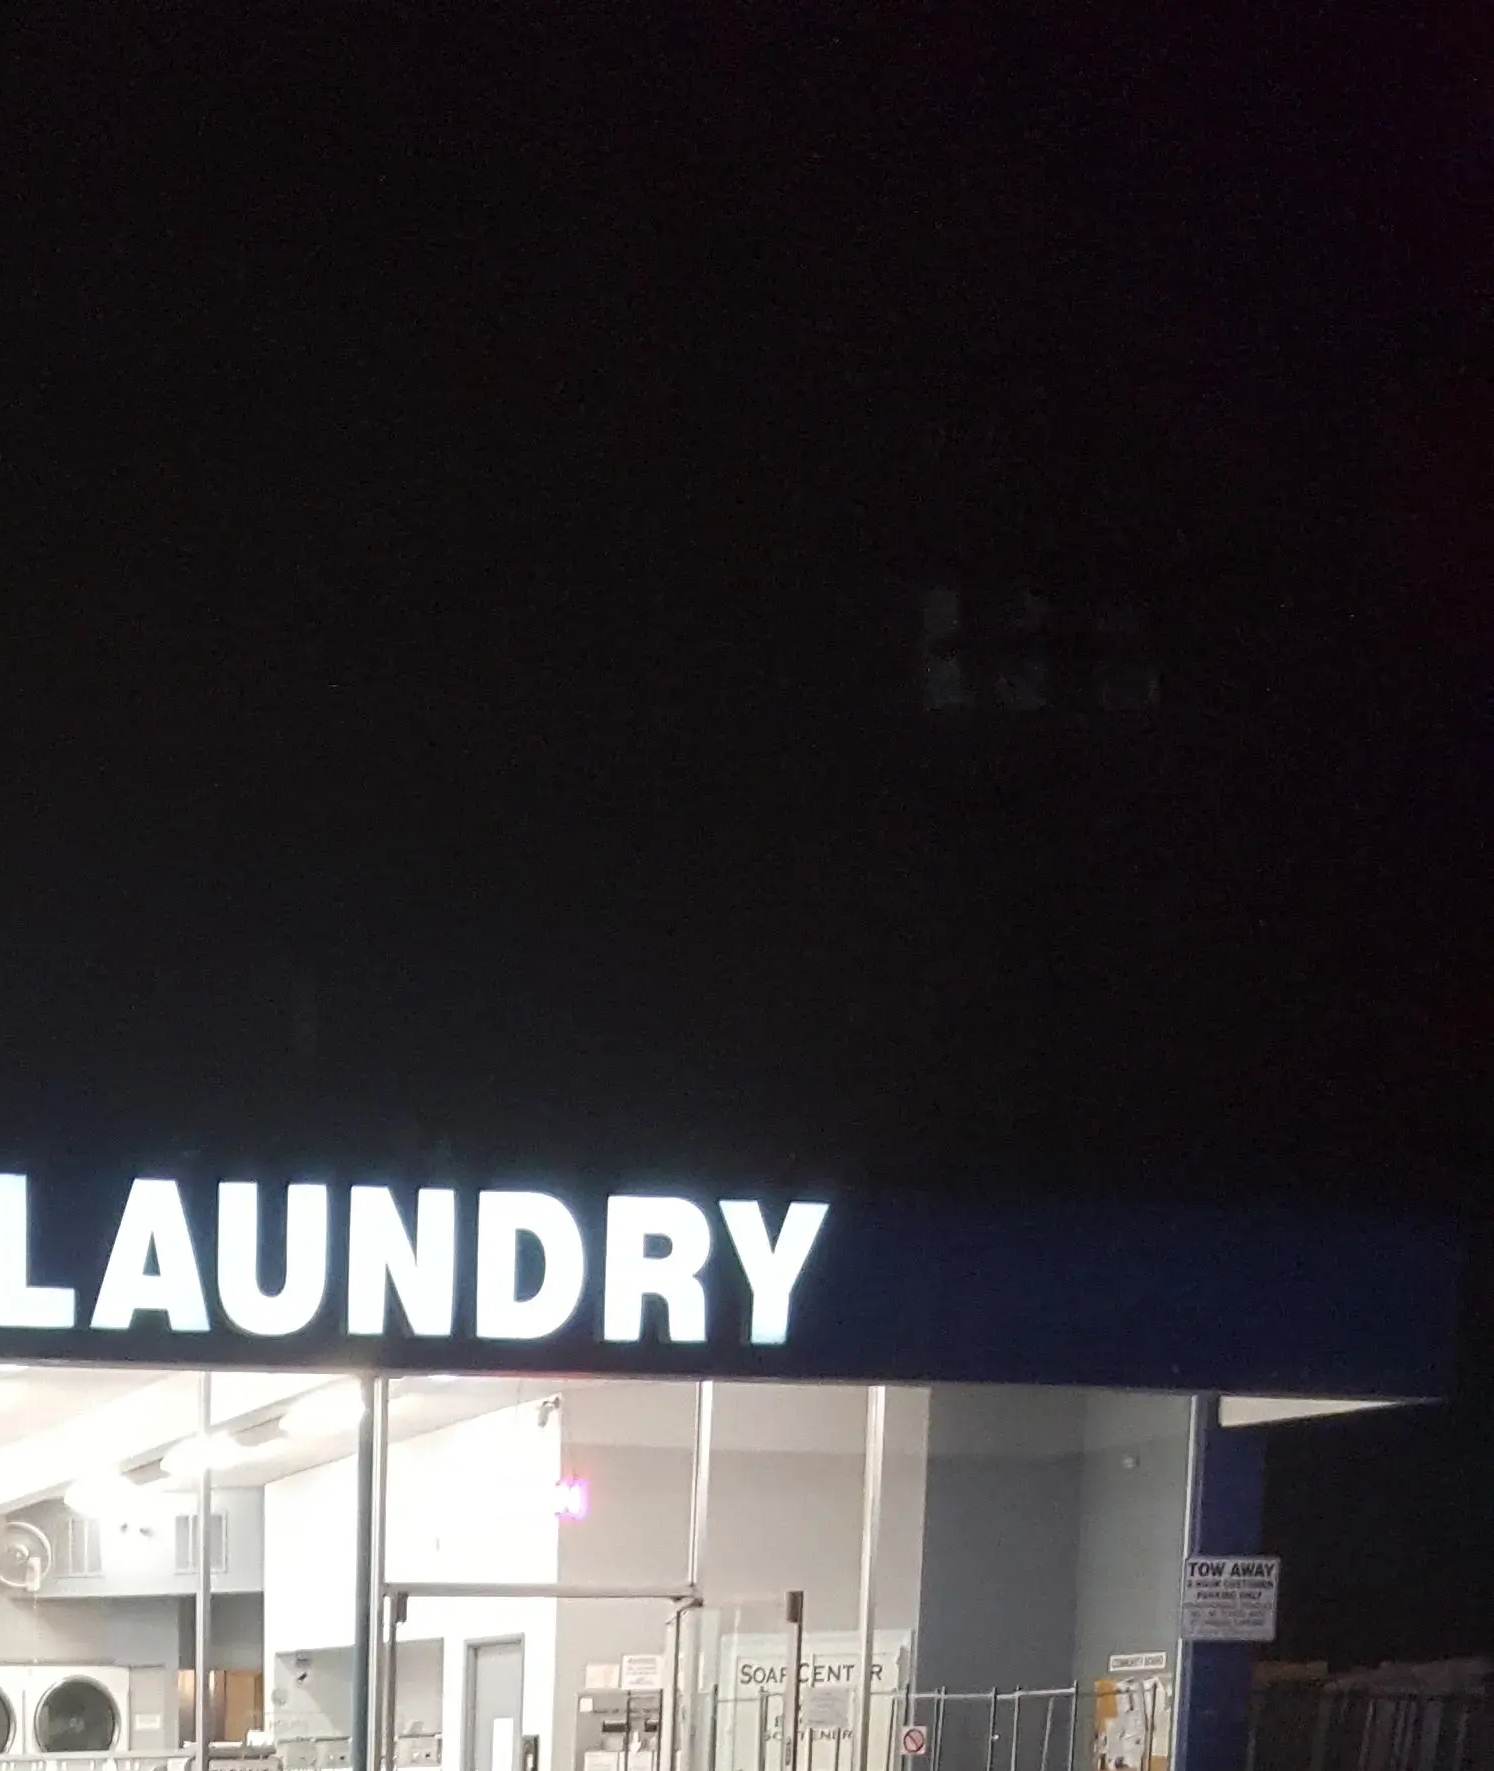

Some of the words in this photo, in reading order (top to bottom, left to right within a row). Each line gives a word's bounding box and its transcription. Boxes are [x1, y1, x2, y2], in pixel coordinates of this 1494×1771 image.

[1187, 1562, 1226, 1577] TOW
[1230, 1562, 1275, 1577] AWAY
[798, 1662, 883, 1685] CENTR
